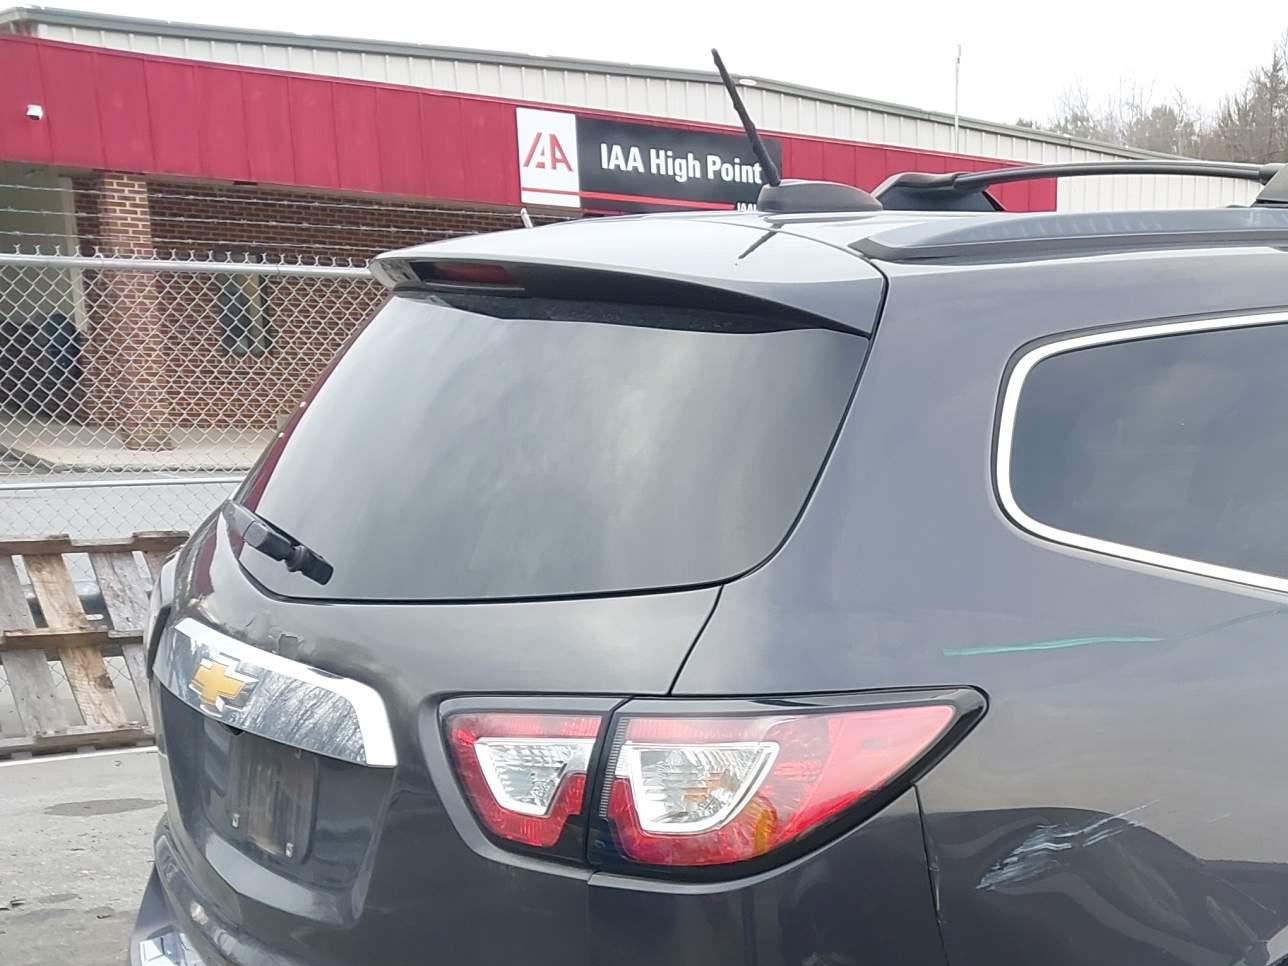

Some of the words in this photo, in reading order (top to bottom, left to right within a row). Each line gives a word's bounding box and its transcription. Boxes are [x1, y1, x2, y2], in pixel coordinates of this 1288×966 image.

[600, 143, 645, 174] IAA
[650, 148, 701, 184] High
[707, 154, 762, 185] Point
